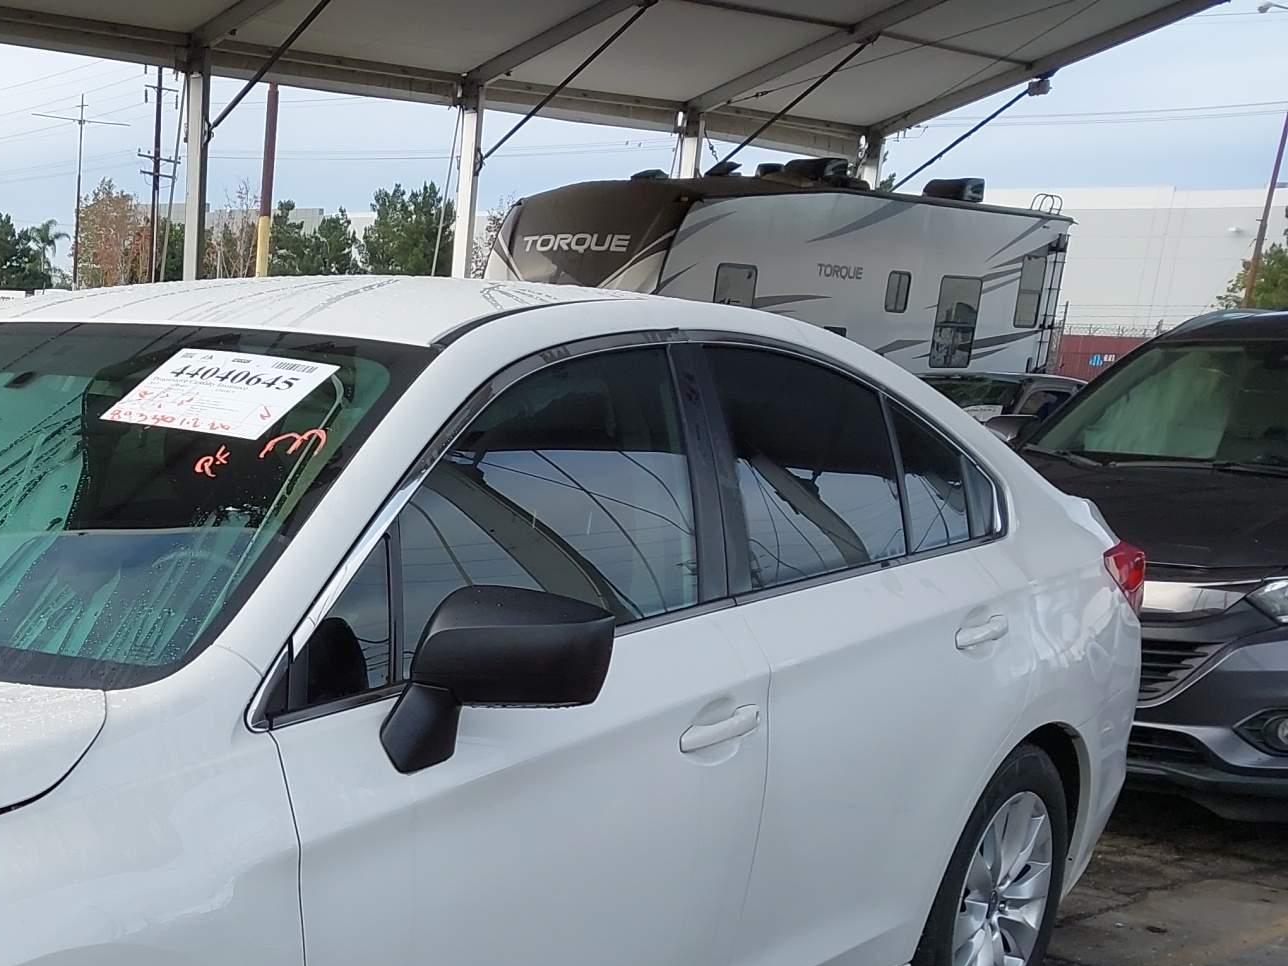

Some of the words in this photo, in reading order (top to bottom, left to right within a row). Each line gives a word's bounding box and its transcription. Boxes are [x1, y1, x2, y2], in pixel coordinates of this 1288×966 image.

[523, 233, 632, 254] TORQUE
[817, 263, 864, 280] TORQUE
[169, 364, 301, 391] 44040645
